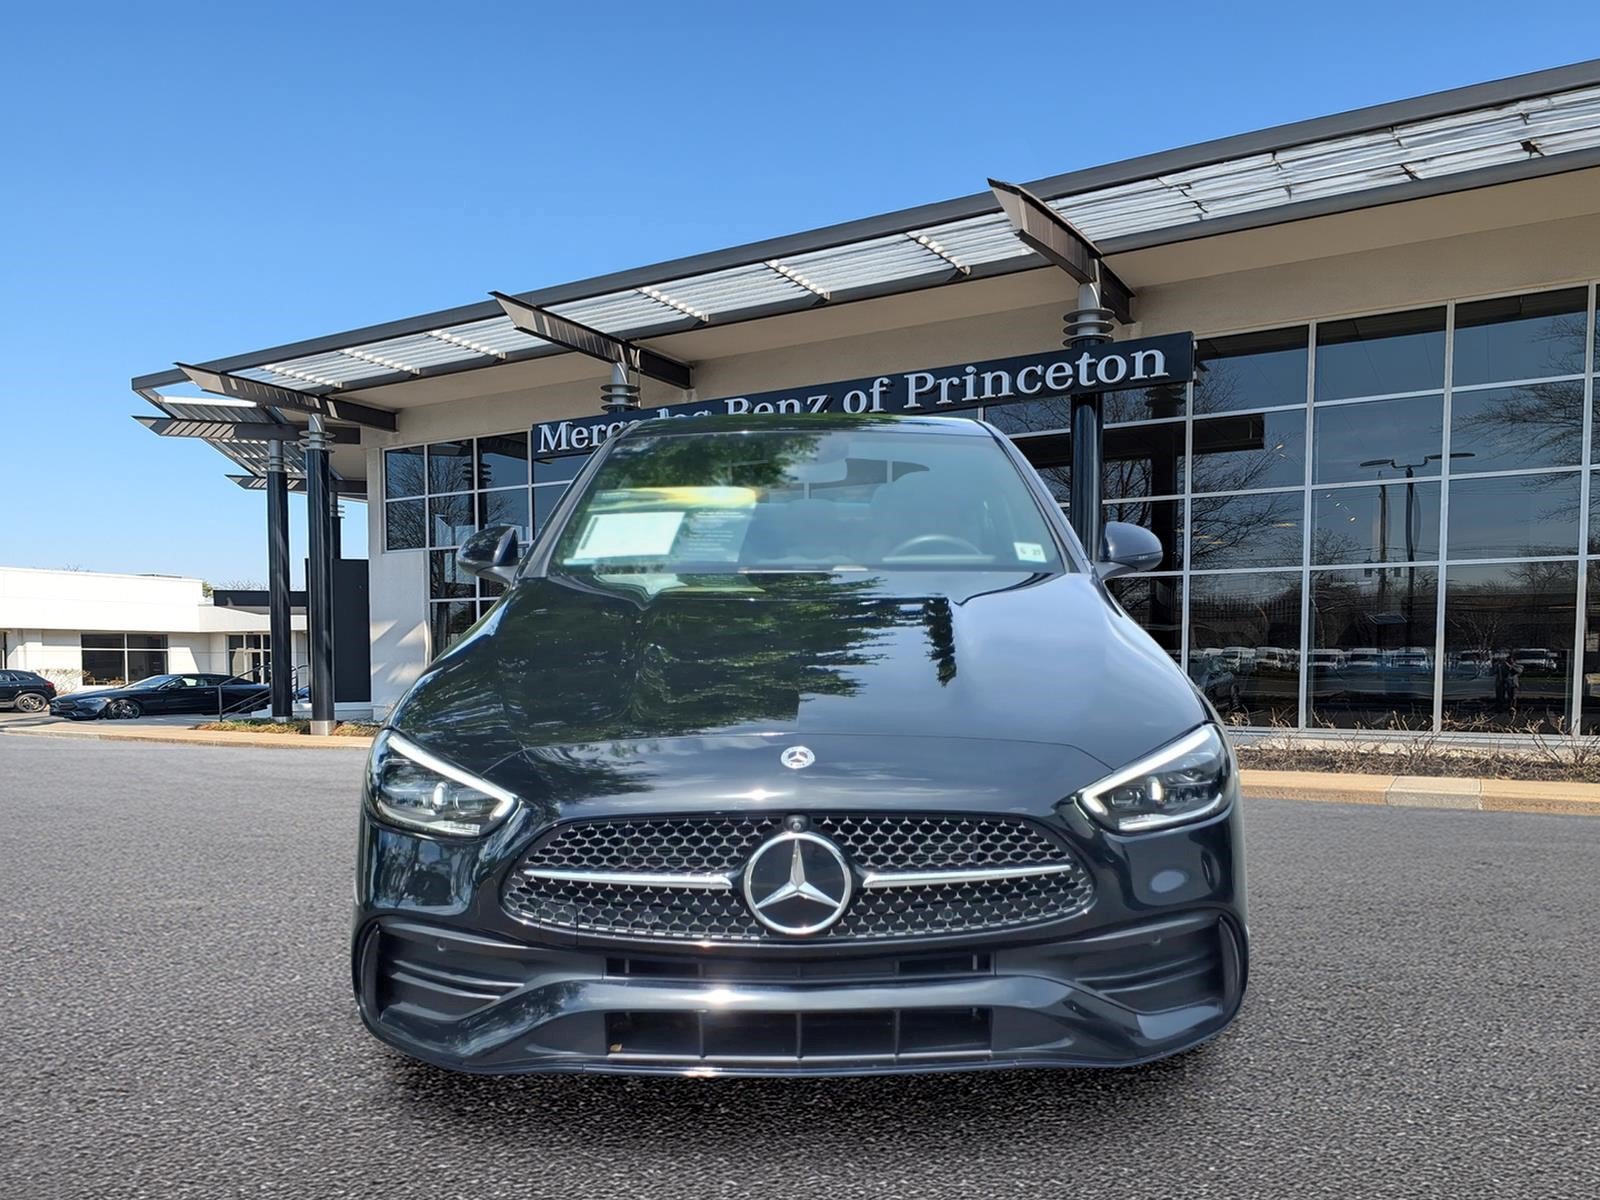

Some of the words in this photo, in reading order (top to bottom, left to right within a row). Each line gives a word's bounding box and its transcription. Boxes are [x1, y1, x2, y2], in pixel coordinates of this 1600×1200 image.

[537, 408, 712, 453] Merc
[842, 376, 891, 414] of
[903, 349, 1170, 409] Princeton
